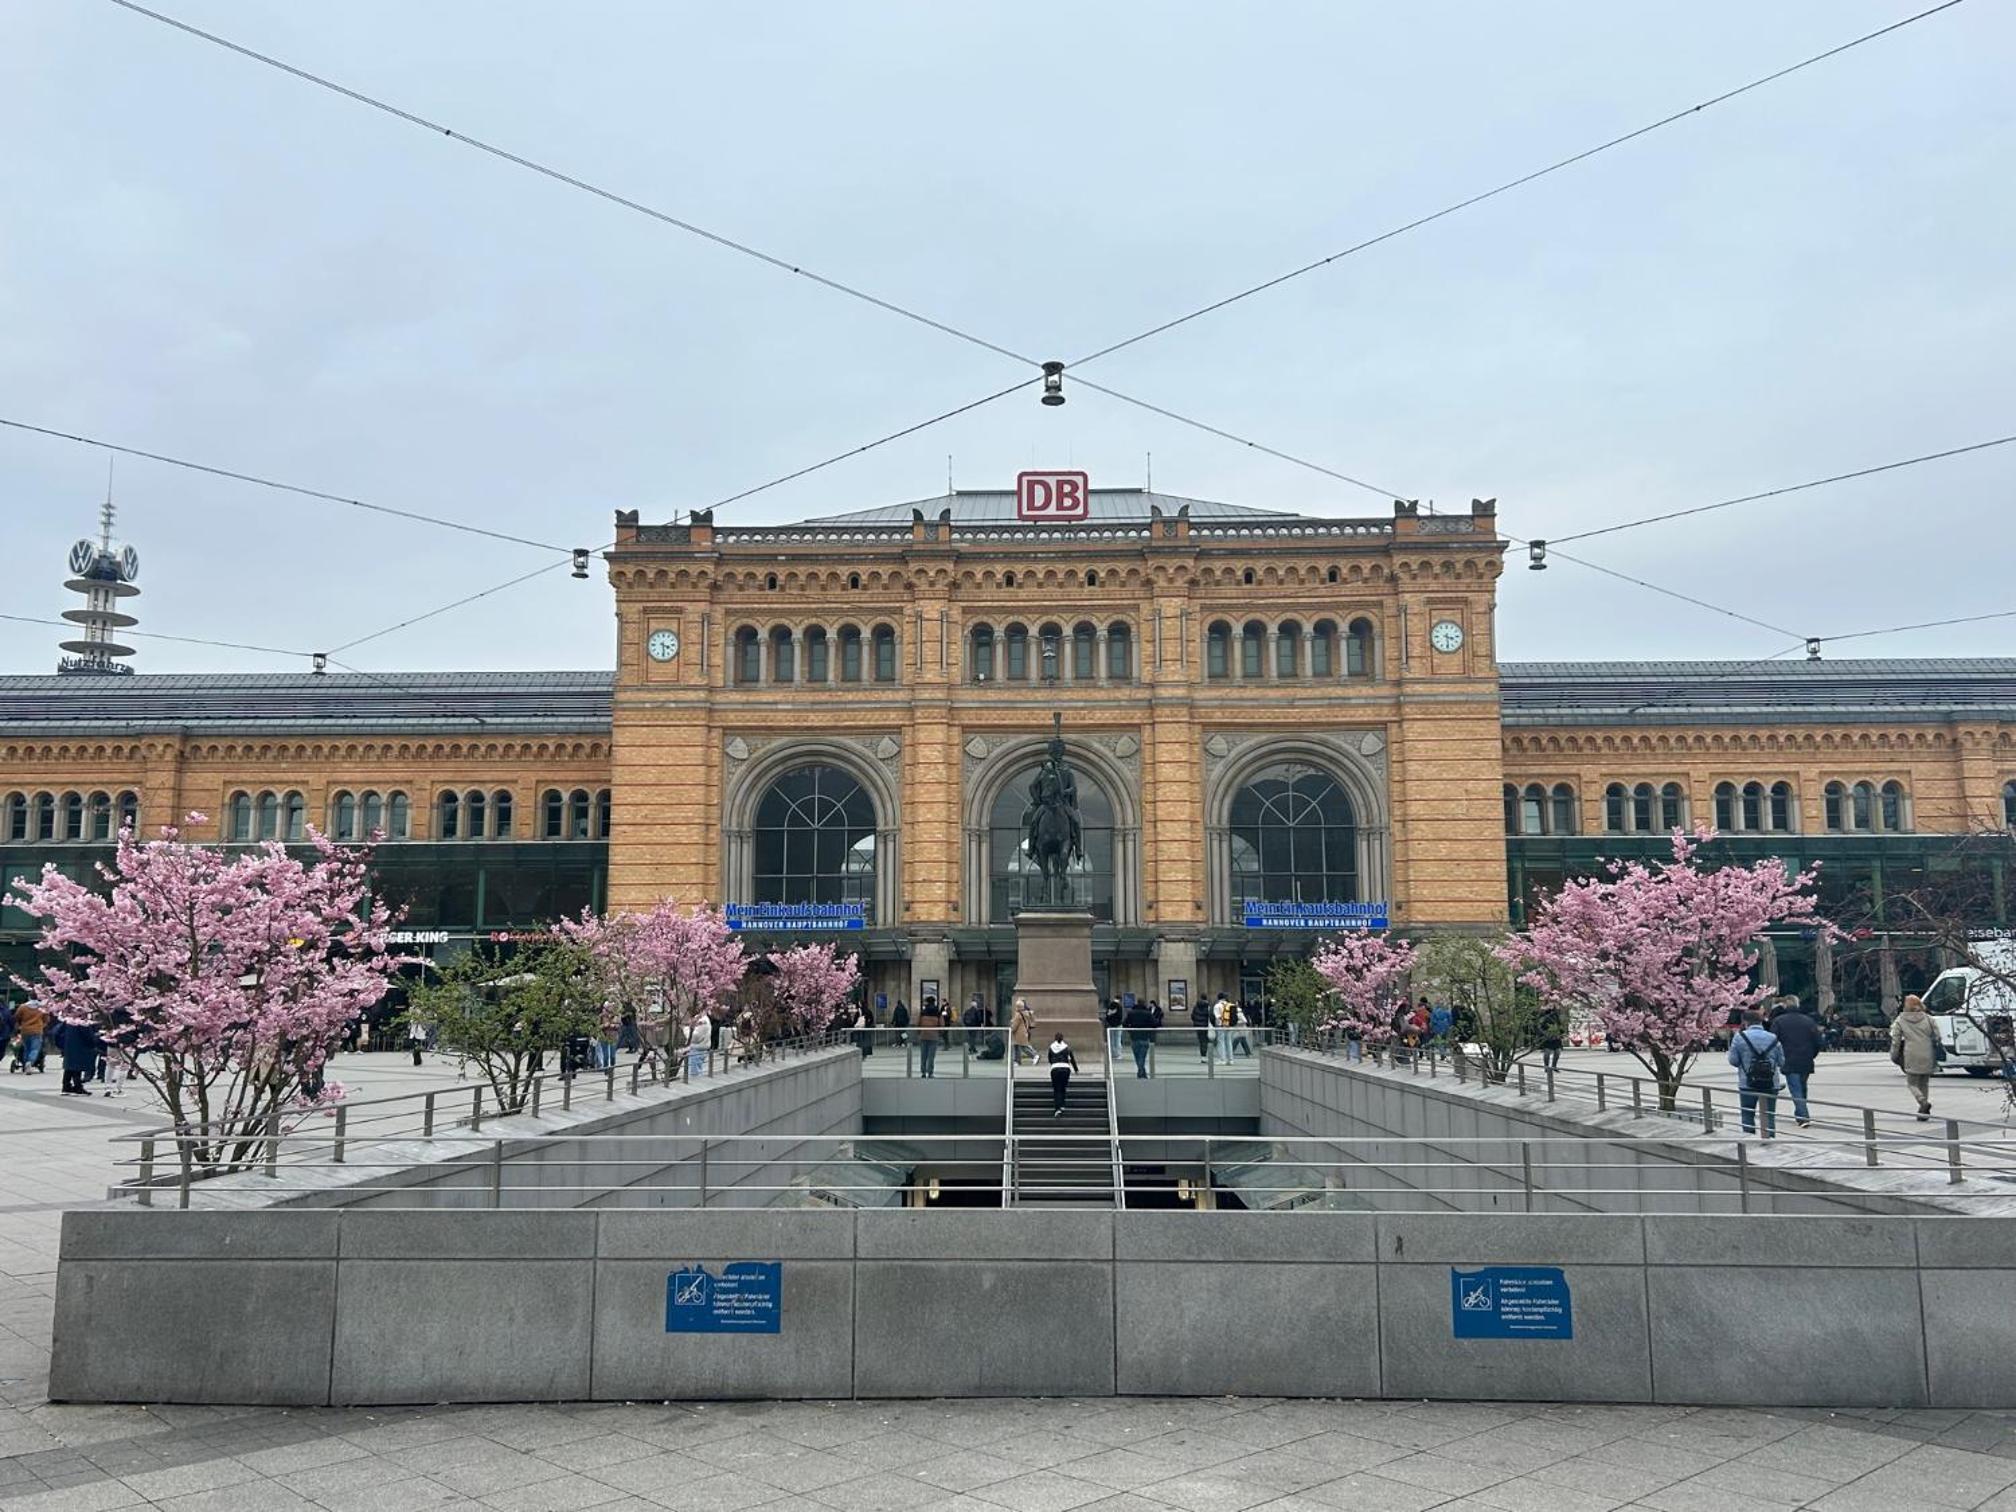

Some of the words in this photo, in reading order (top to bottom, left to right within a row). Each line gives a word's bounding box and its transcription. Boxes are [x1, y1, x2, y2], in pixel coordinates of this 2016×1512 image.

[1026, 479, 1081, 511] DB
[726, 902, 758, 916] Mein
[760, 901, 864, 916] Einkaufsbahnhof
[1245, 901, 1278, 915] Mein
[741, 920, 783, 929] HANNOVER
[1261, 918, 1305, 927] HANNOVER
[416, 931, 448, 943] KING
